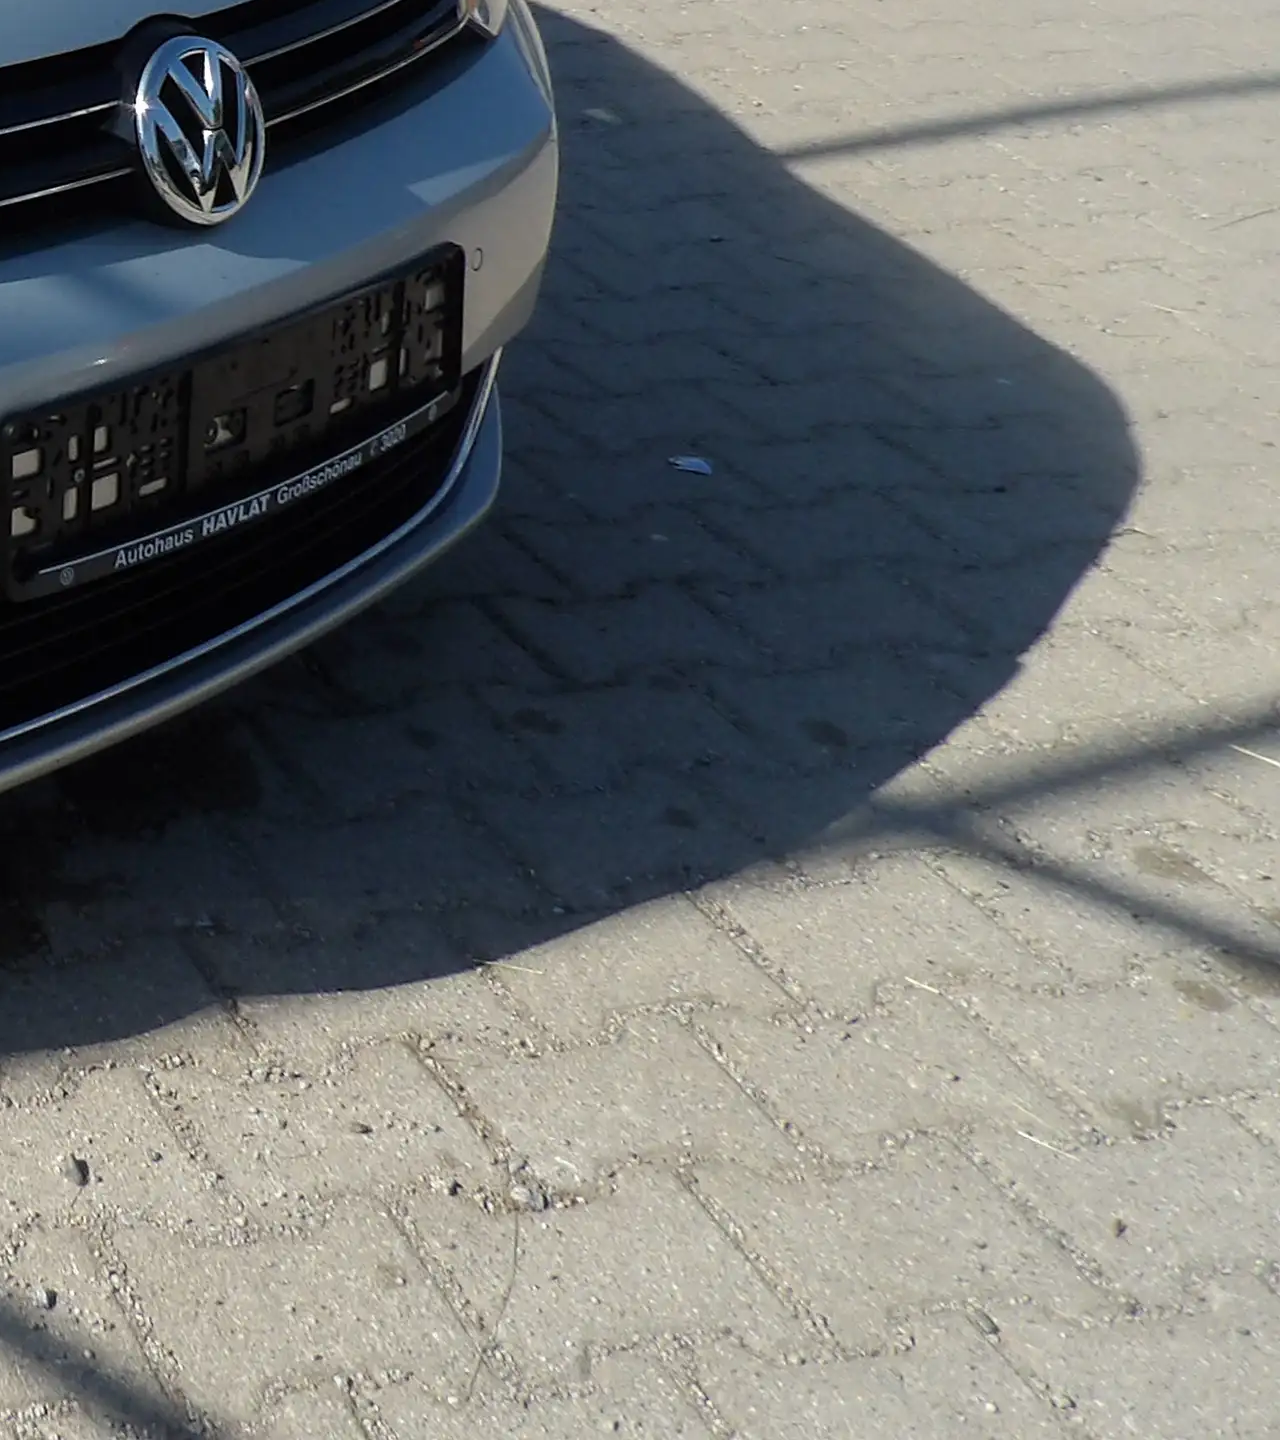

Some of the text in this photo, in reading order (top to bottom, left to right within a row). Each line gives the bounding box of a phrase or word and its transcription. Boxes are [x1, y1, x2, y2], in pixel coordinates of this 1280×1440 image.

[114, 529, 194, 569] Autohaus
[201, 494, 271, 537] HAVLAT
[276, 451, 363, 505] Großschönau
